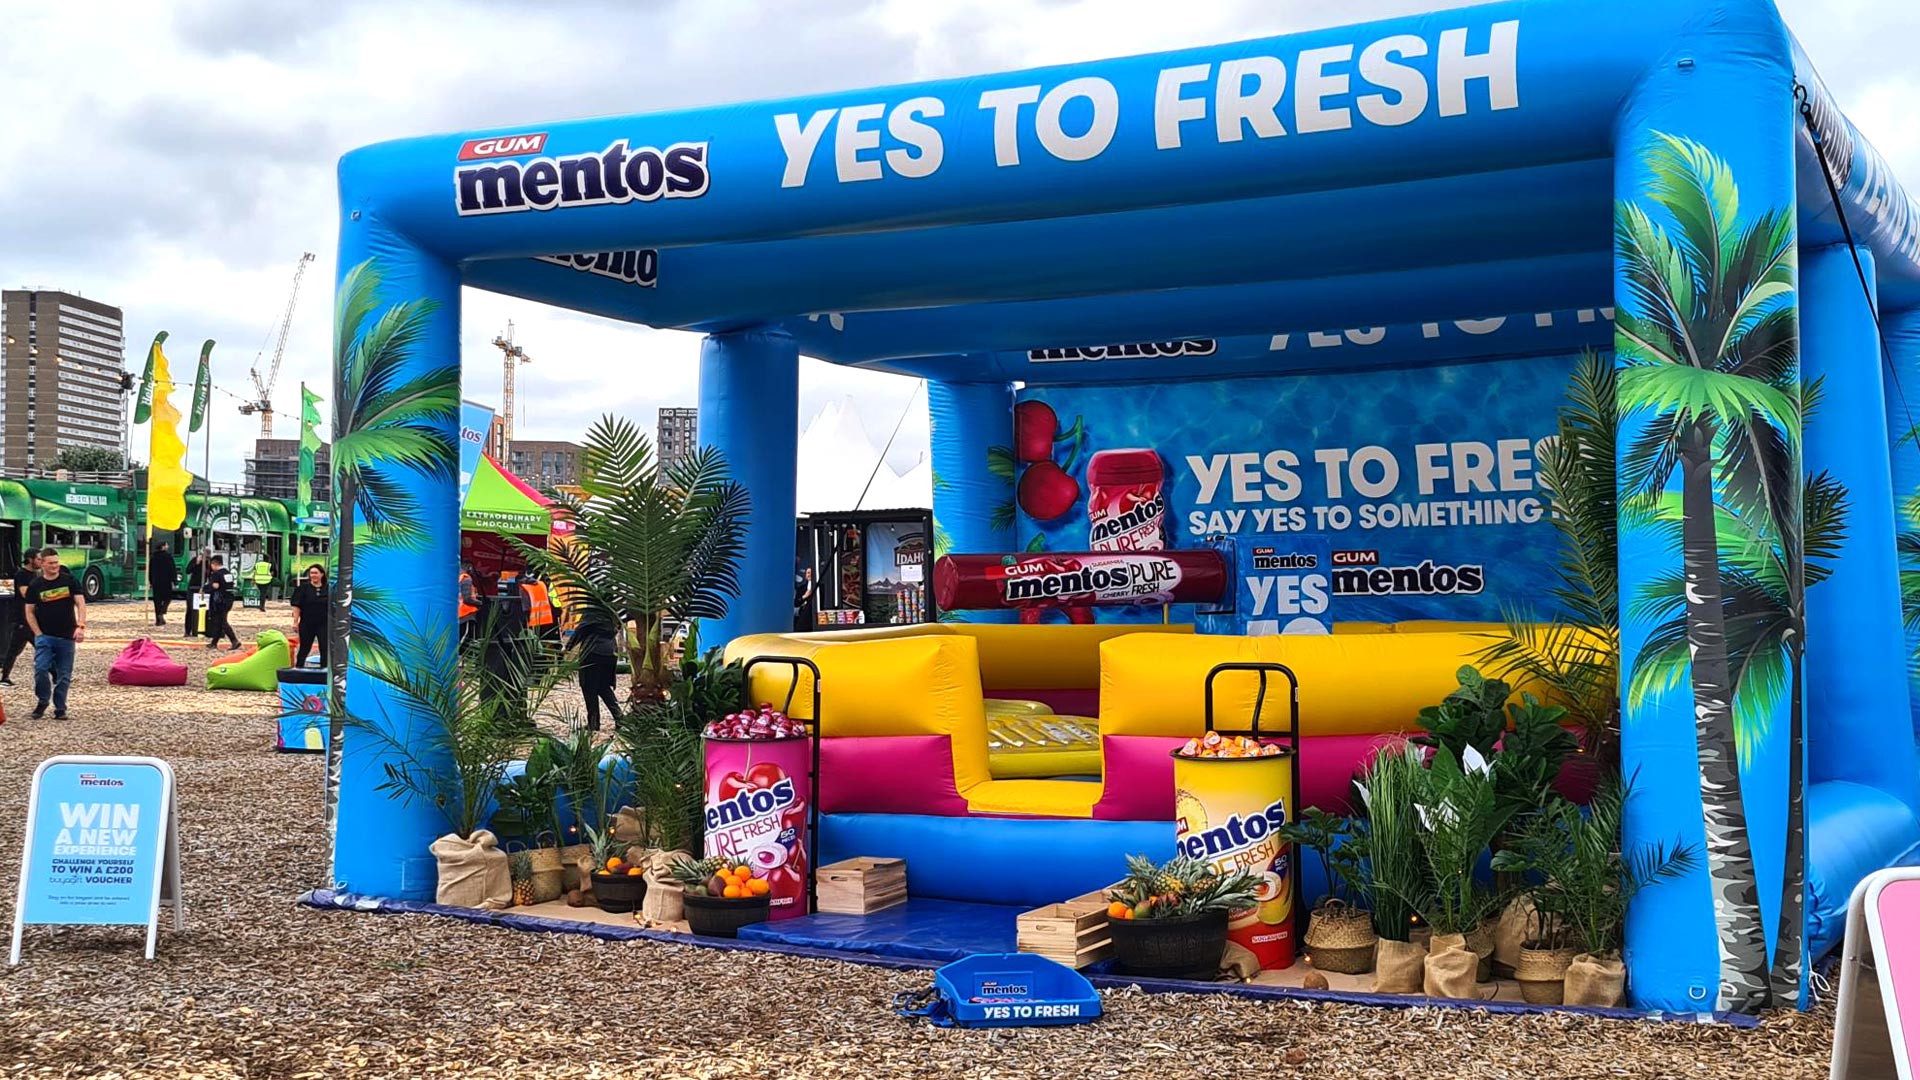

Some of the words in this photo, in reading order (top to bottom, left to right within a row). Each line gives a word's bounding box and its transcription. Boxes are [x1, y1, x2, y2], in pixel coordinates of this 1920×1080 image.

[774, 97, 944, 187] YES
[979, 76, 1119, 167] TO
[1154, 19, 1519, 150] FRESH
[473, 134, 541, 156] GUM
[457, 141, 706, 213] mentos
[461, 426, 483, 443] tos
[1186, 450, 1300, 504] YES
[1315, 445, 1399, 500] TO
[466, 511, 541, 522] EXTRAORDINARY
[1089, 509, 1106, 519] UM
[1091, 493, 1164, 542] mentos
[1189, 509, 1245, 535] SAY
[1253, 507, 1306, 533] YES
[1313, 505, 1352, 531] TO
[1359, 498, 1544, 529] SOMETHING
[476, 520, 532, 530] CHOCOLATE
[896, 552, 924, 565] IDAH
[1254, 553, 1317, 569] mentos
[1332, 552, 1376, 564] GUM
[1005, 564, 1044, 576] GUM
[1131, 560, 1177, 584] PURE
[1332, 560, 1485, 595] mentos
[1008, 567, 1130, 600] mentos
[1102, 590, 1130, 599] CHERRY
[1132, 583, 1160, 596] FRESH
[1245, 574, 1329, 616] YES
[704, 779, 794, 833] entos
[59, 802, 140, 829] WIN
[742, 815, 780, 840] FRESH
[781, 828, 795, 838] 50
[55, 828, 73, 845] A
[80, 829, 138, 846] NEW
[53, 845, 137, 856] EXPERIENCE
[1234, 841, 1274, 870] FRESH
[51, 865, 66, 874] TO
[69, 865, 93, 874] WIN
[95, 866, 103, 874] A
[106, 866, 134, 875] £200
[85, 876, 133, 884] VOUCHER
[982, 984, 1027, 995] mentos
[984, 1007, 1012, 1019] YES
[1014, 1006, 1032, 1018] TO
[1035, 1005, 1080, 1017] FRESH
